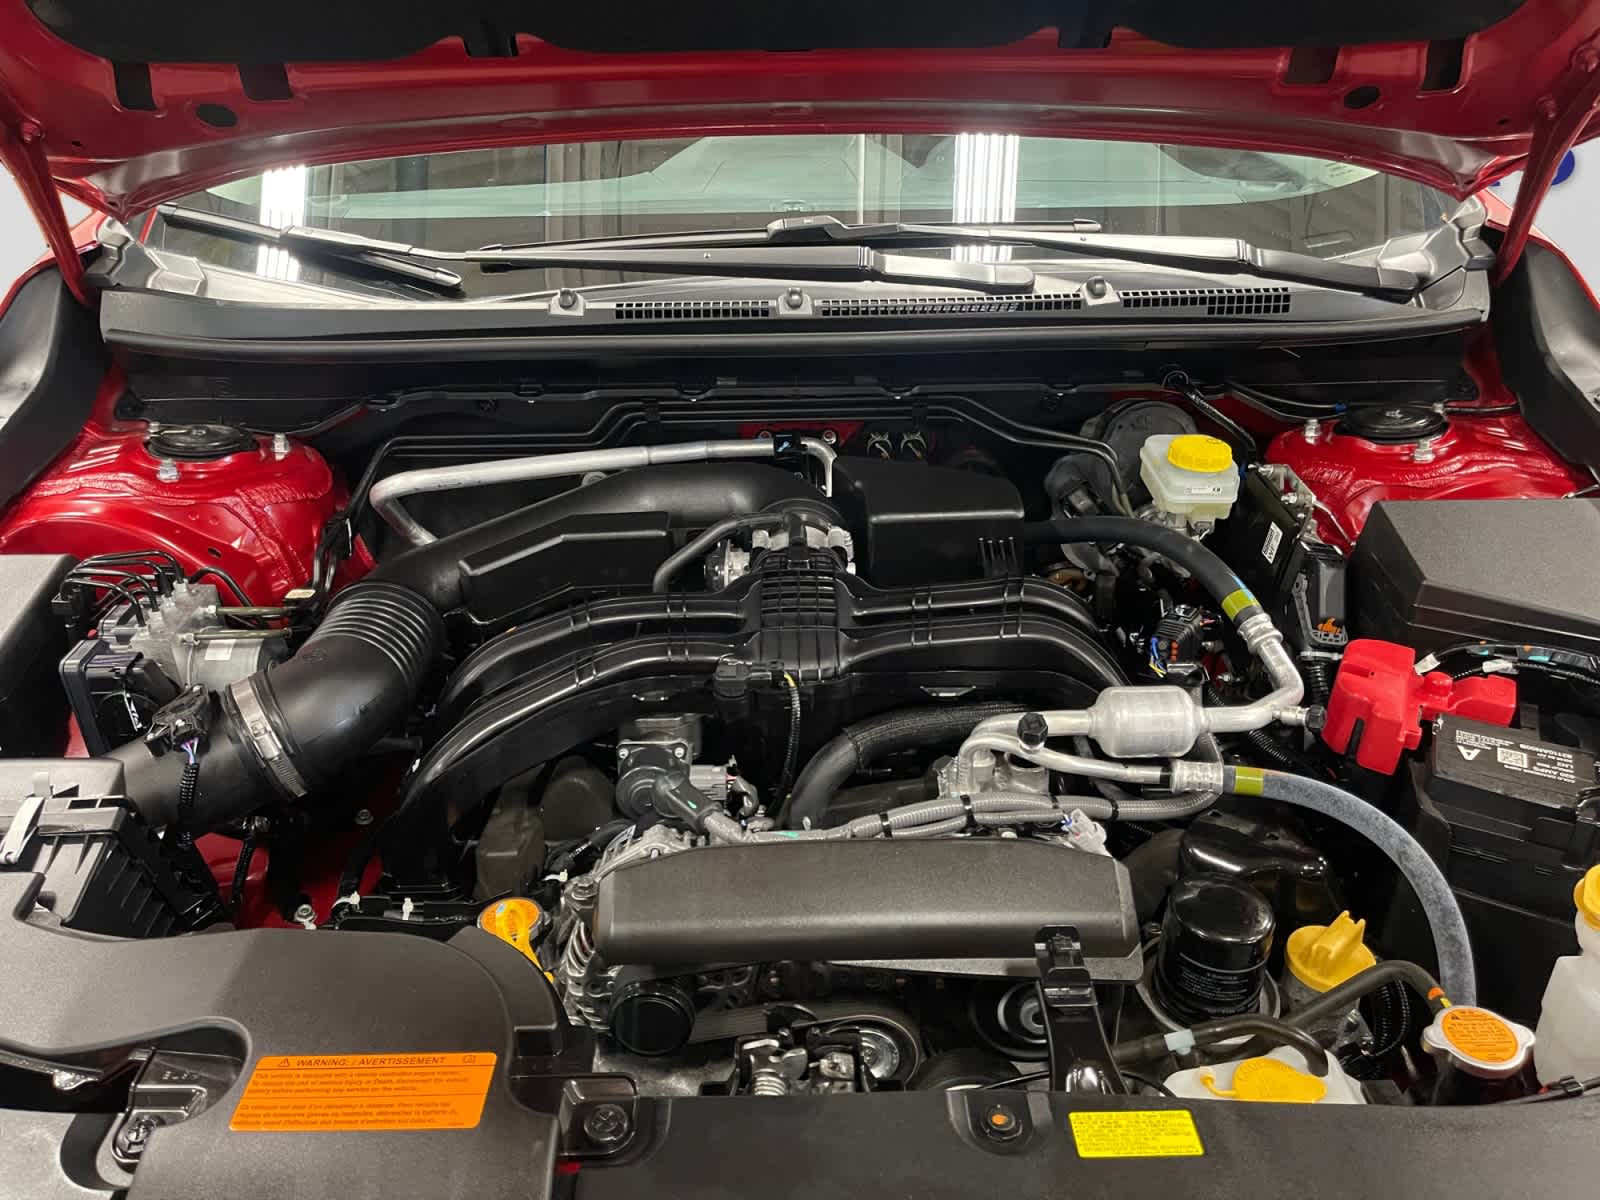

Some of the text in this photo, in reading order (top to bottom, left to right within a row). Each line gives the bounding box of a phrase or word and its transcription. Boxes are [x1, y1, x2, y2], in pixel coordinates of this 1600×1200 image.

[1456, 744, 1481, 761] A
[296, 1058, 349, 1067] WARNING:
[359, 1056, 448, 1066] AVERTISSEMENT
